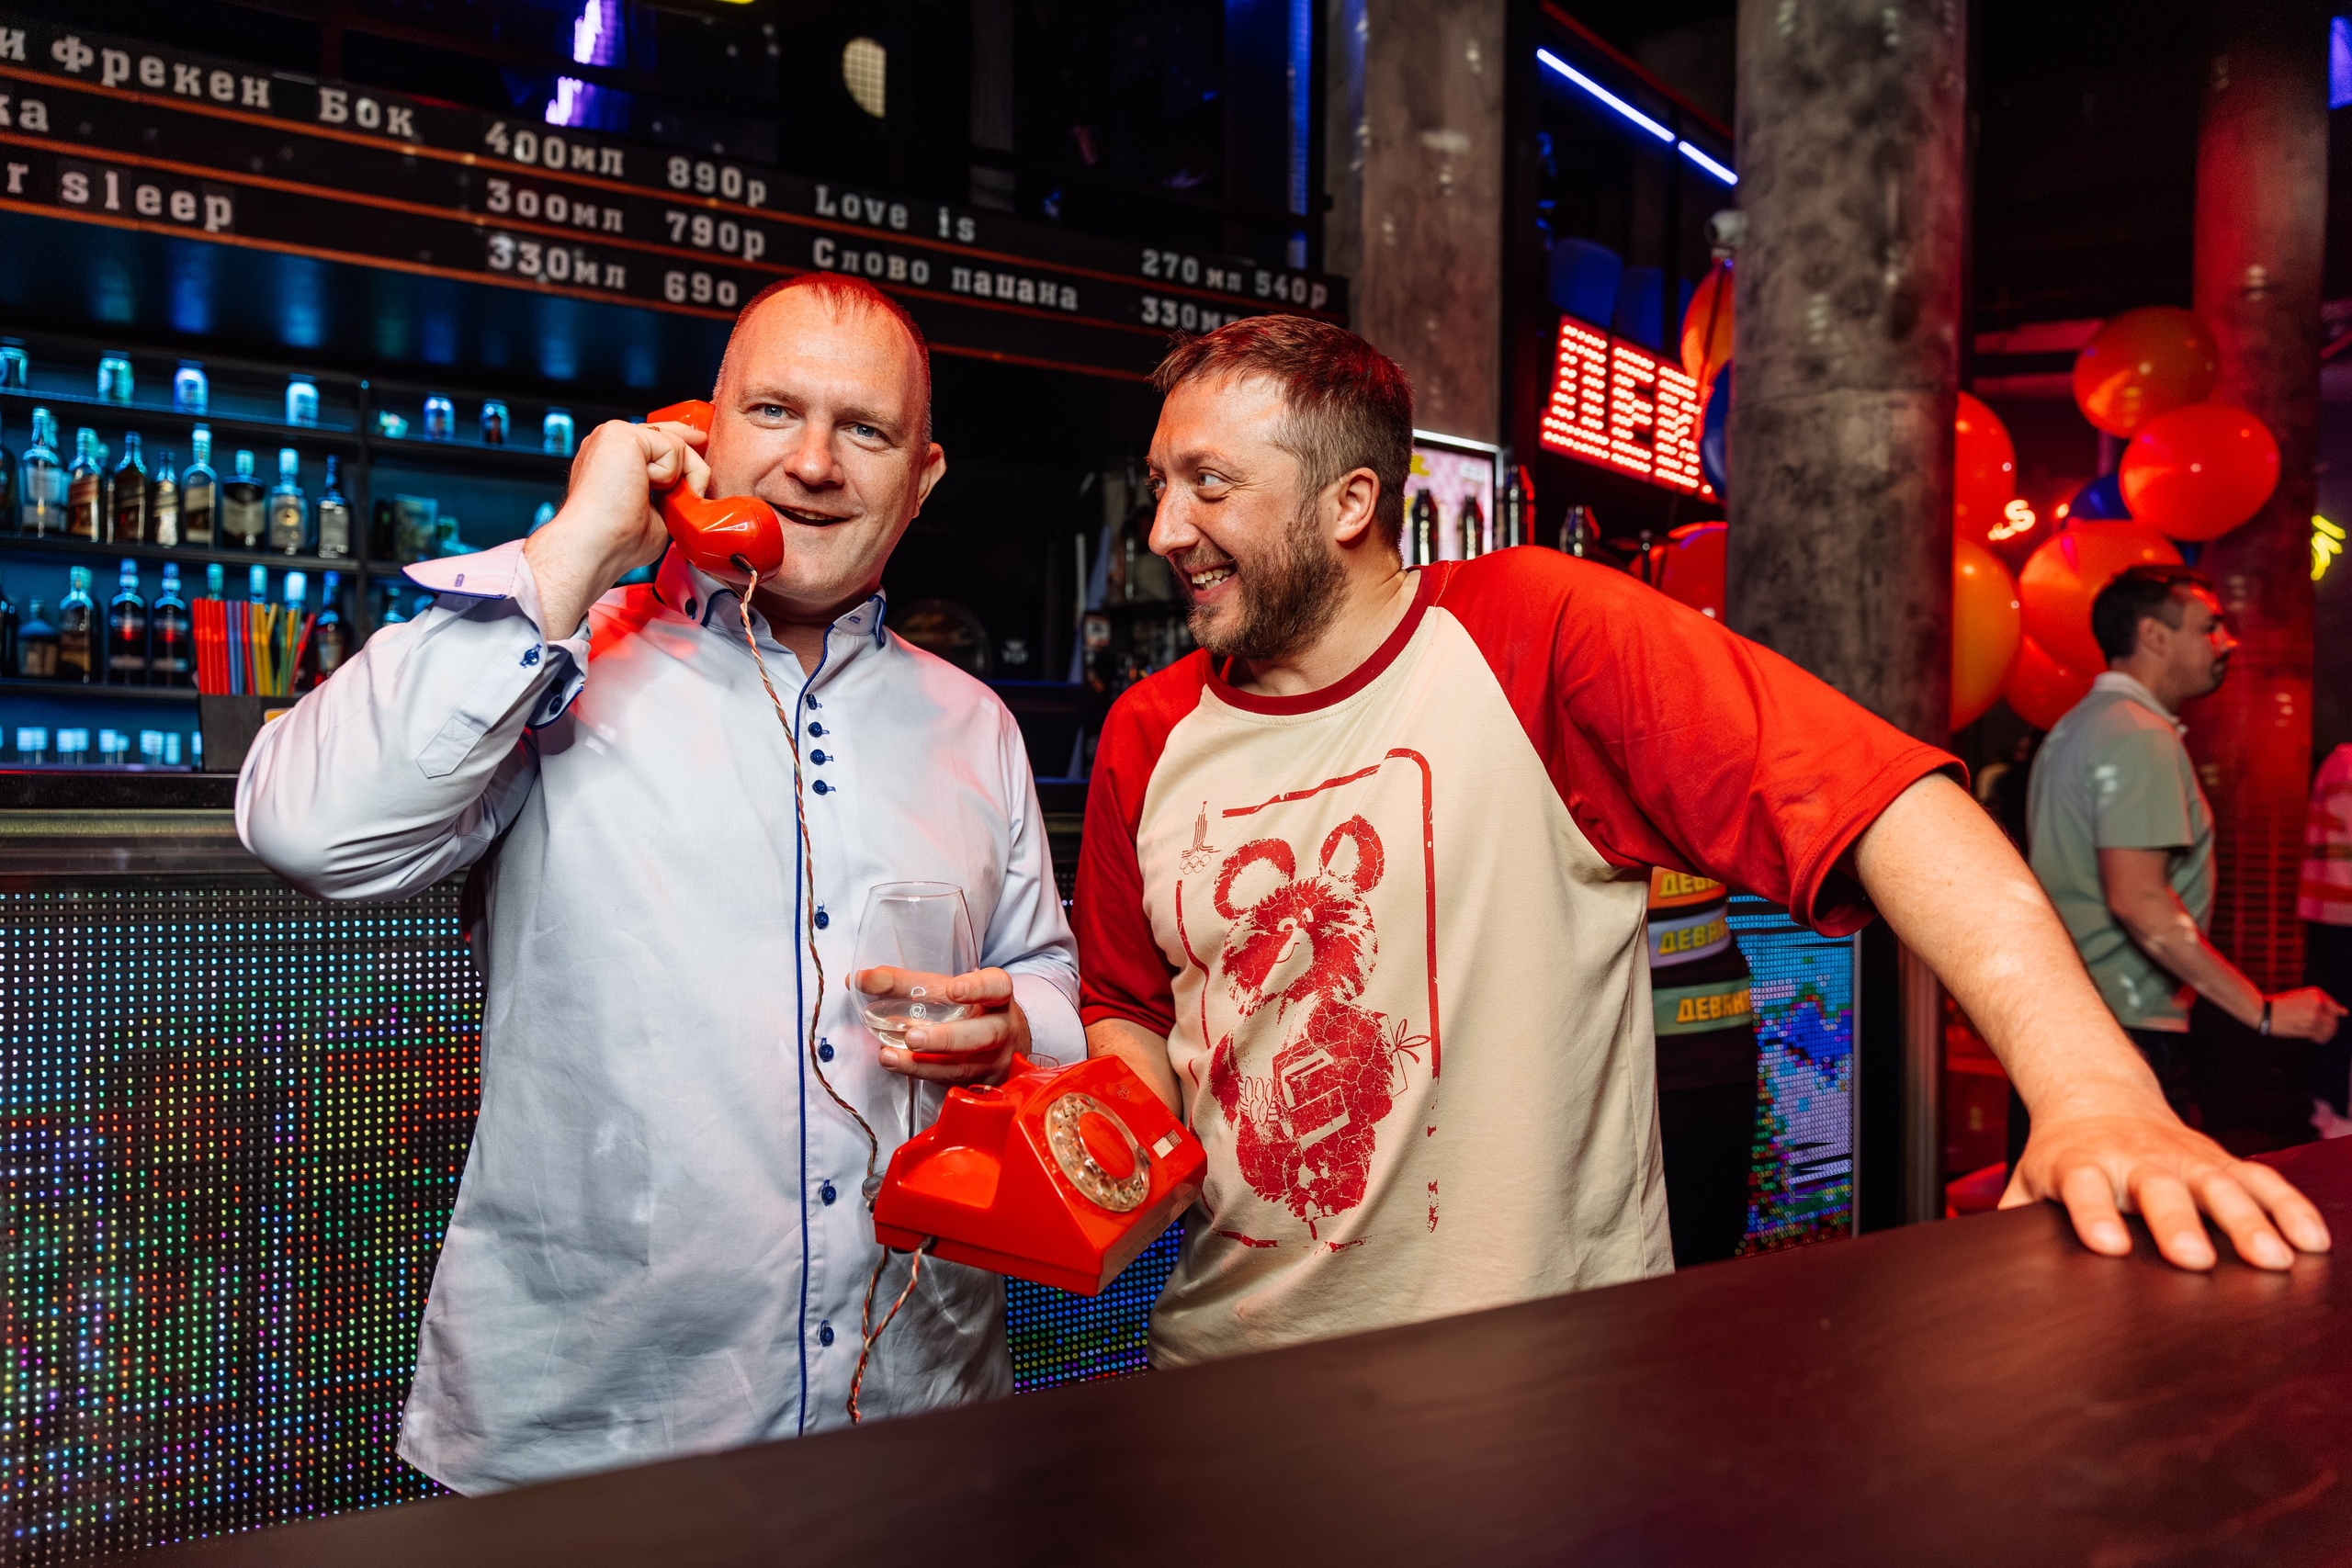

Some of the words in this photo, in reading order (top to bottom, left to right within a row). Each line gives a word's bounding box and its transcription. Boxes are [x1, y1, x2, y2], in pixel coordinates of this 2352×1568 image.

[51, 35, 270, 108] Фрекен
[318, 87, 414, 137] Бок
[667, 155, 767, 208] 890р
[61, 171, 233, 232] sleep
[815, 185, 909, 230] Love
[938, 205, 976, 243] is
[488, 233, 627, 289] 330мл
[664, 209, 765, 262] 790р
[812, 237, 930, 285] Слово
[1141, 248, 1199, 284] 270
[1543, 324, 1712, 495] ДЕВ
